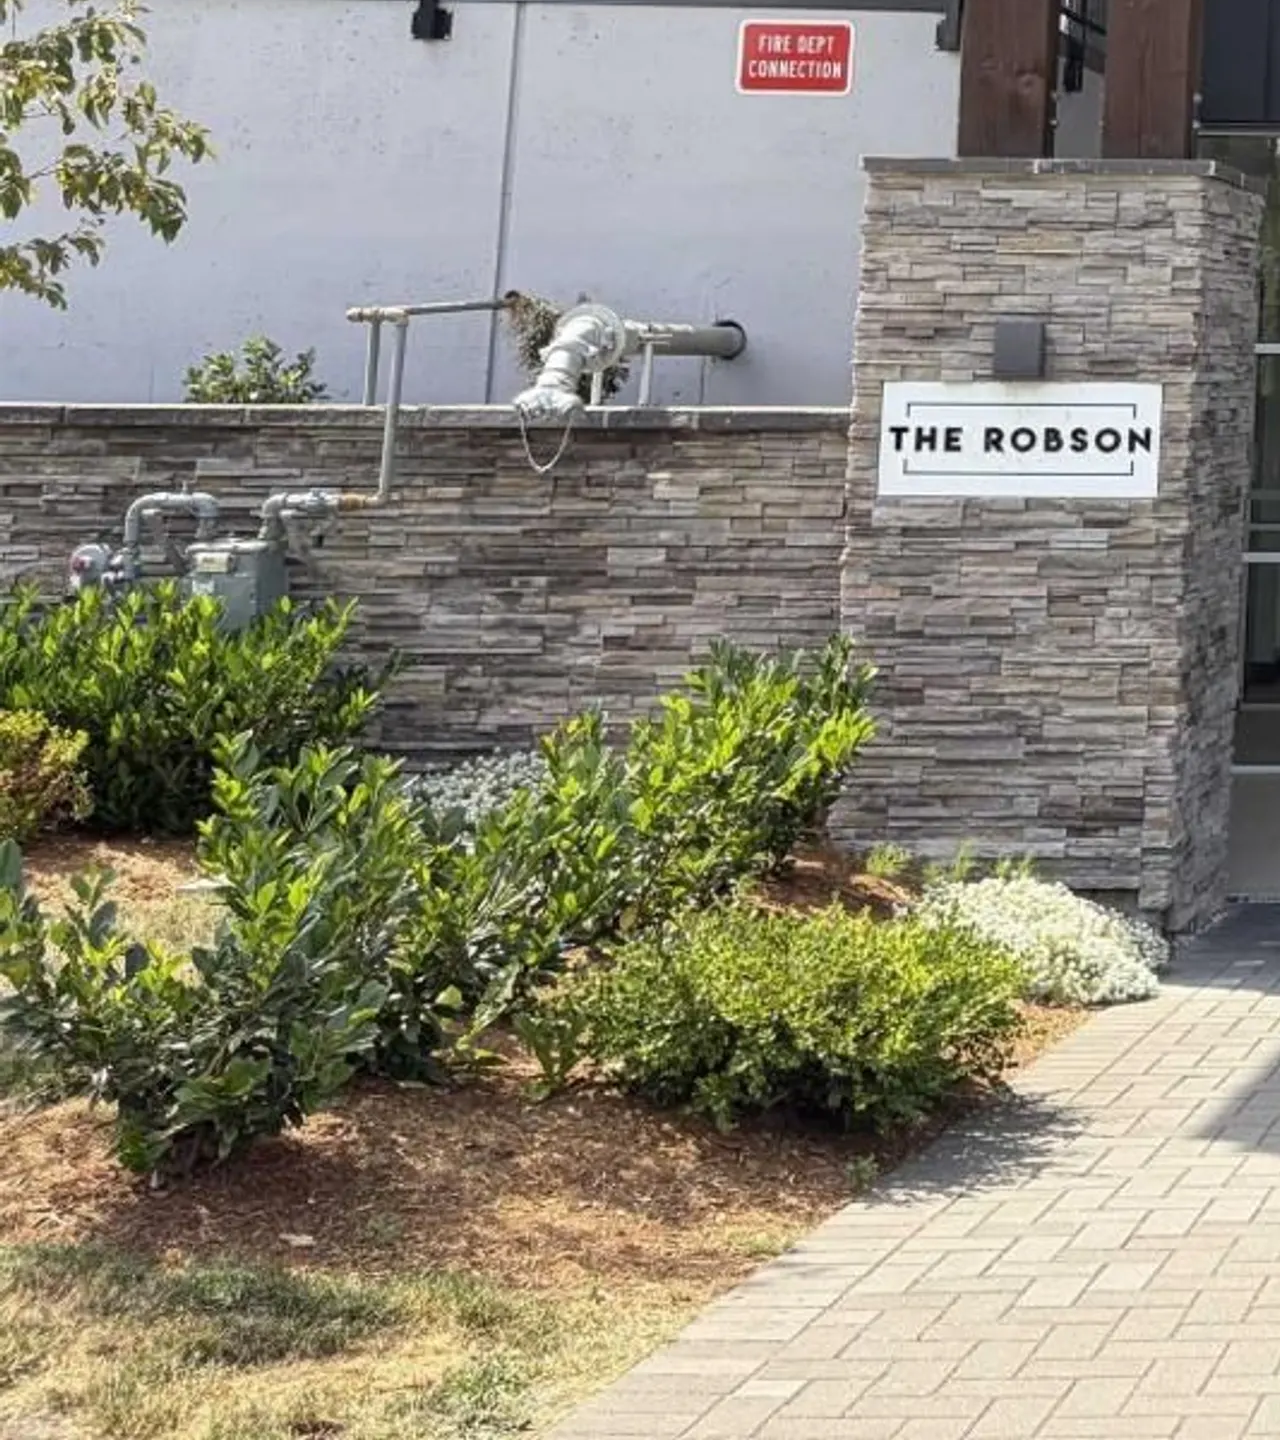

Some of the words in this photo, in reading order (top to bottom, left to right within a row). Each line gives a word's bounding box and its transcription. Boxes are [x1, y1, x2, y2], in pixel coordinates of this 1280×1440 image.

[757, 34, 792, 54] FIRE
[797, 35, 835, 55] DEPT
[749, 60, 842, 79] CONNECTION
[889, 426, 963, 453] THE
[984, 426, 1152, 454] ROBSON
